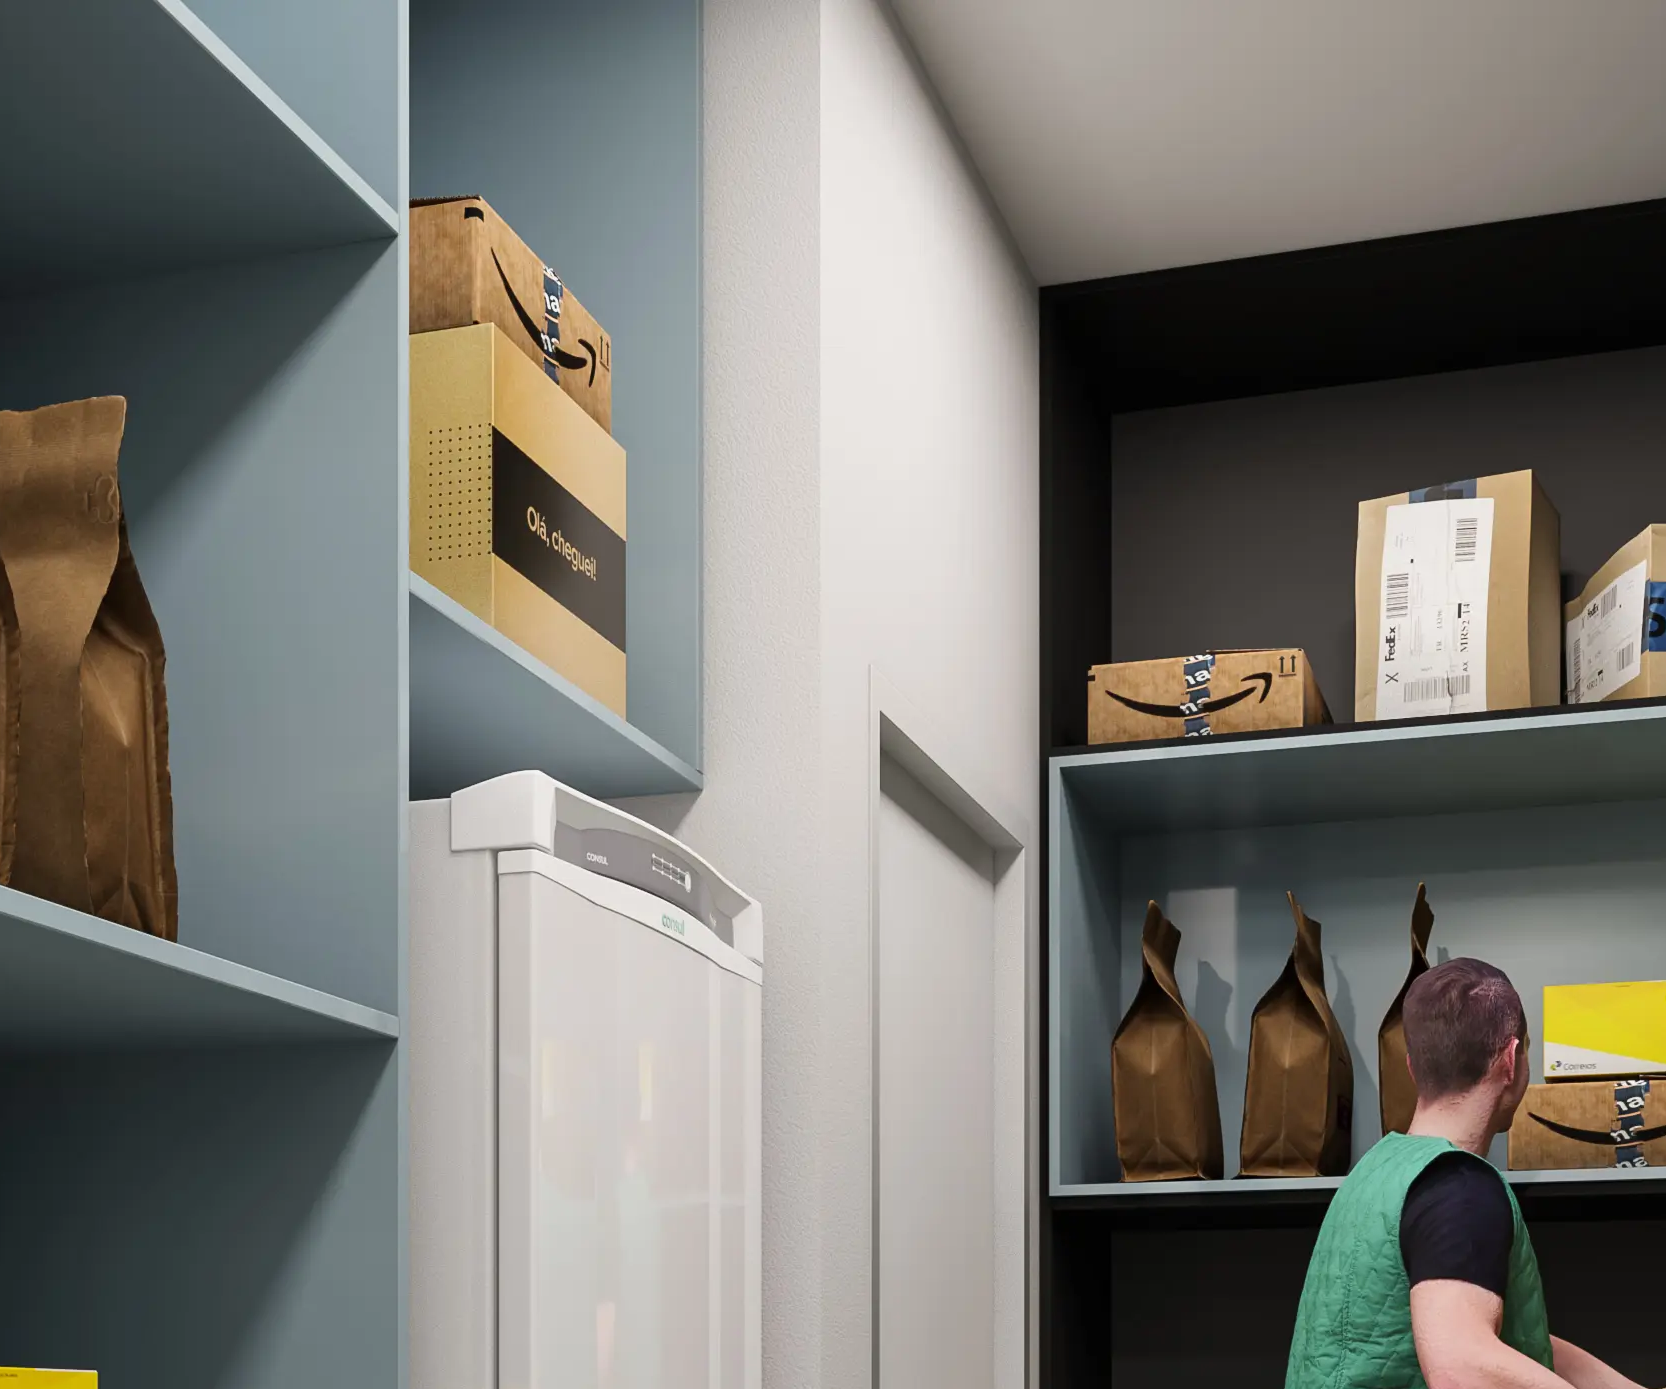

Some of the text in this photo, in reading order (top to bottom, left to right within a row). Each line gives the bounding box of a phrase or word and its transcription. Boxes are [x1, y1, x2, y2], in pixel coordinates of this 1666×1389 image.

[526, 505, 597, 582] Olá, cheguei!
[1384, 625, 1397, 662] FedEx
[585, 851, 610, 867] CONSUL
[661, 913, 686, 937] consul
[1562, 1062, 1597, 1072] Correios
